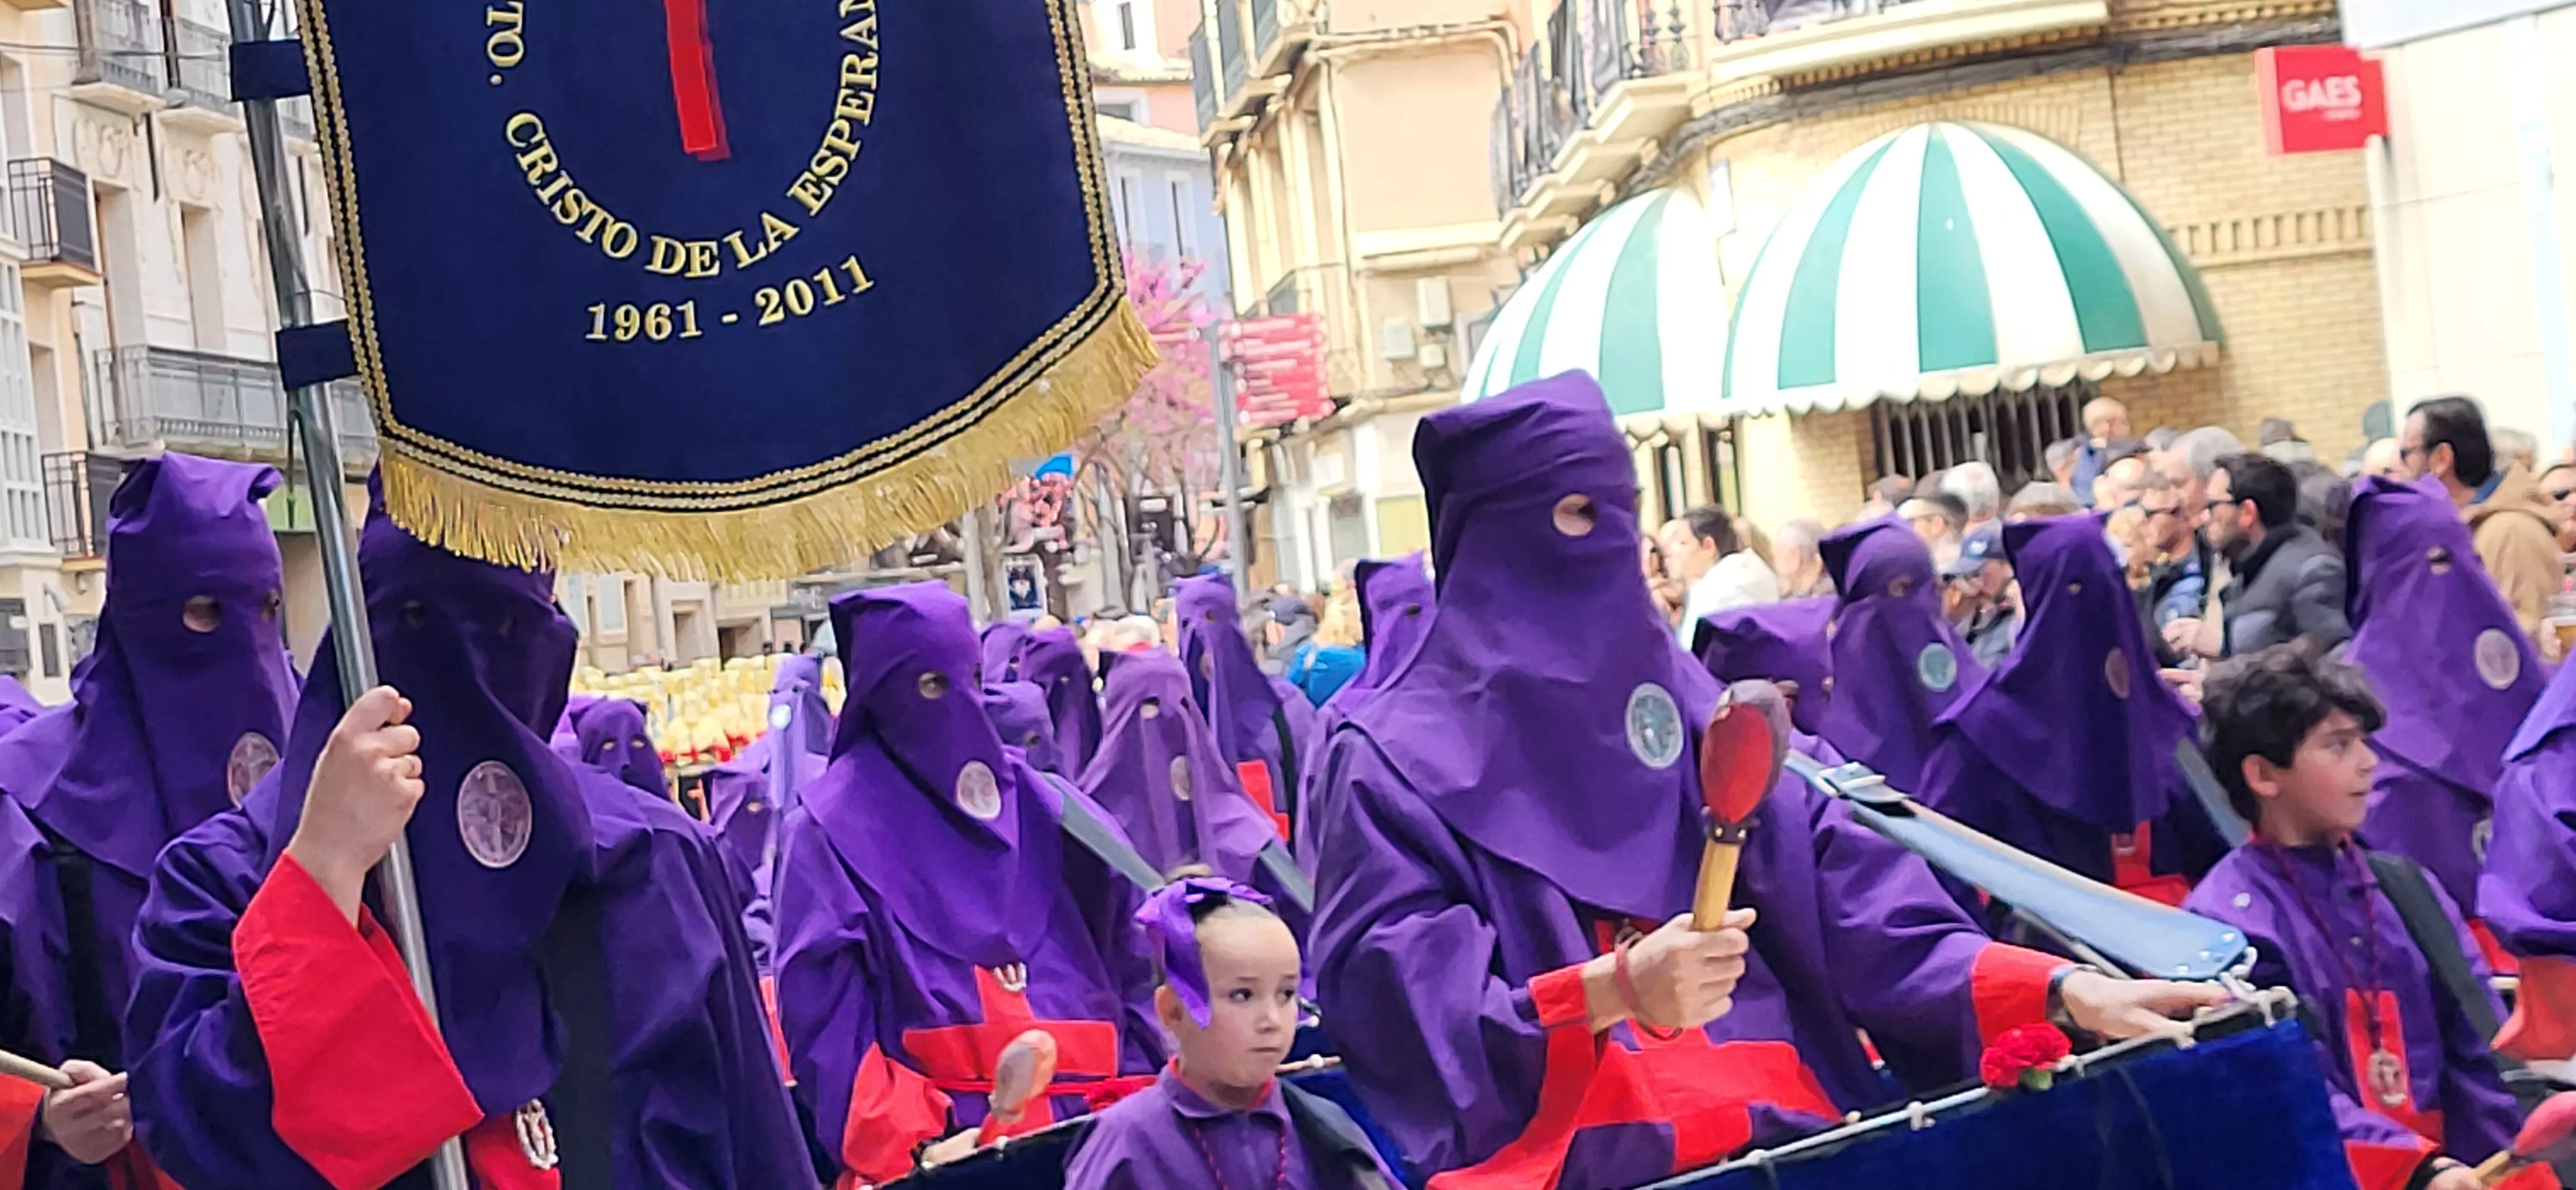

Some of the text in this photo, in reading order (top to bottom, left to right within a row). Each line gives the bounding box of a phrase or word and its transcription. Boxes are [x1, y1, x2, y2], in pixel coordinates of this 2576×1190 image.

[2281, 74, 2362, 112] GAES
[506, 113, 638, 258] CRISTO
[645, 236, 720, 278] DE
[723, 212, 800, 269] LA
[585, 255, 875, 341] 1961 - 2011
